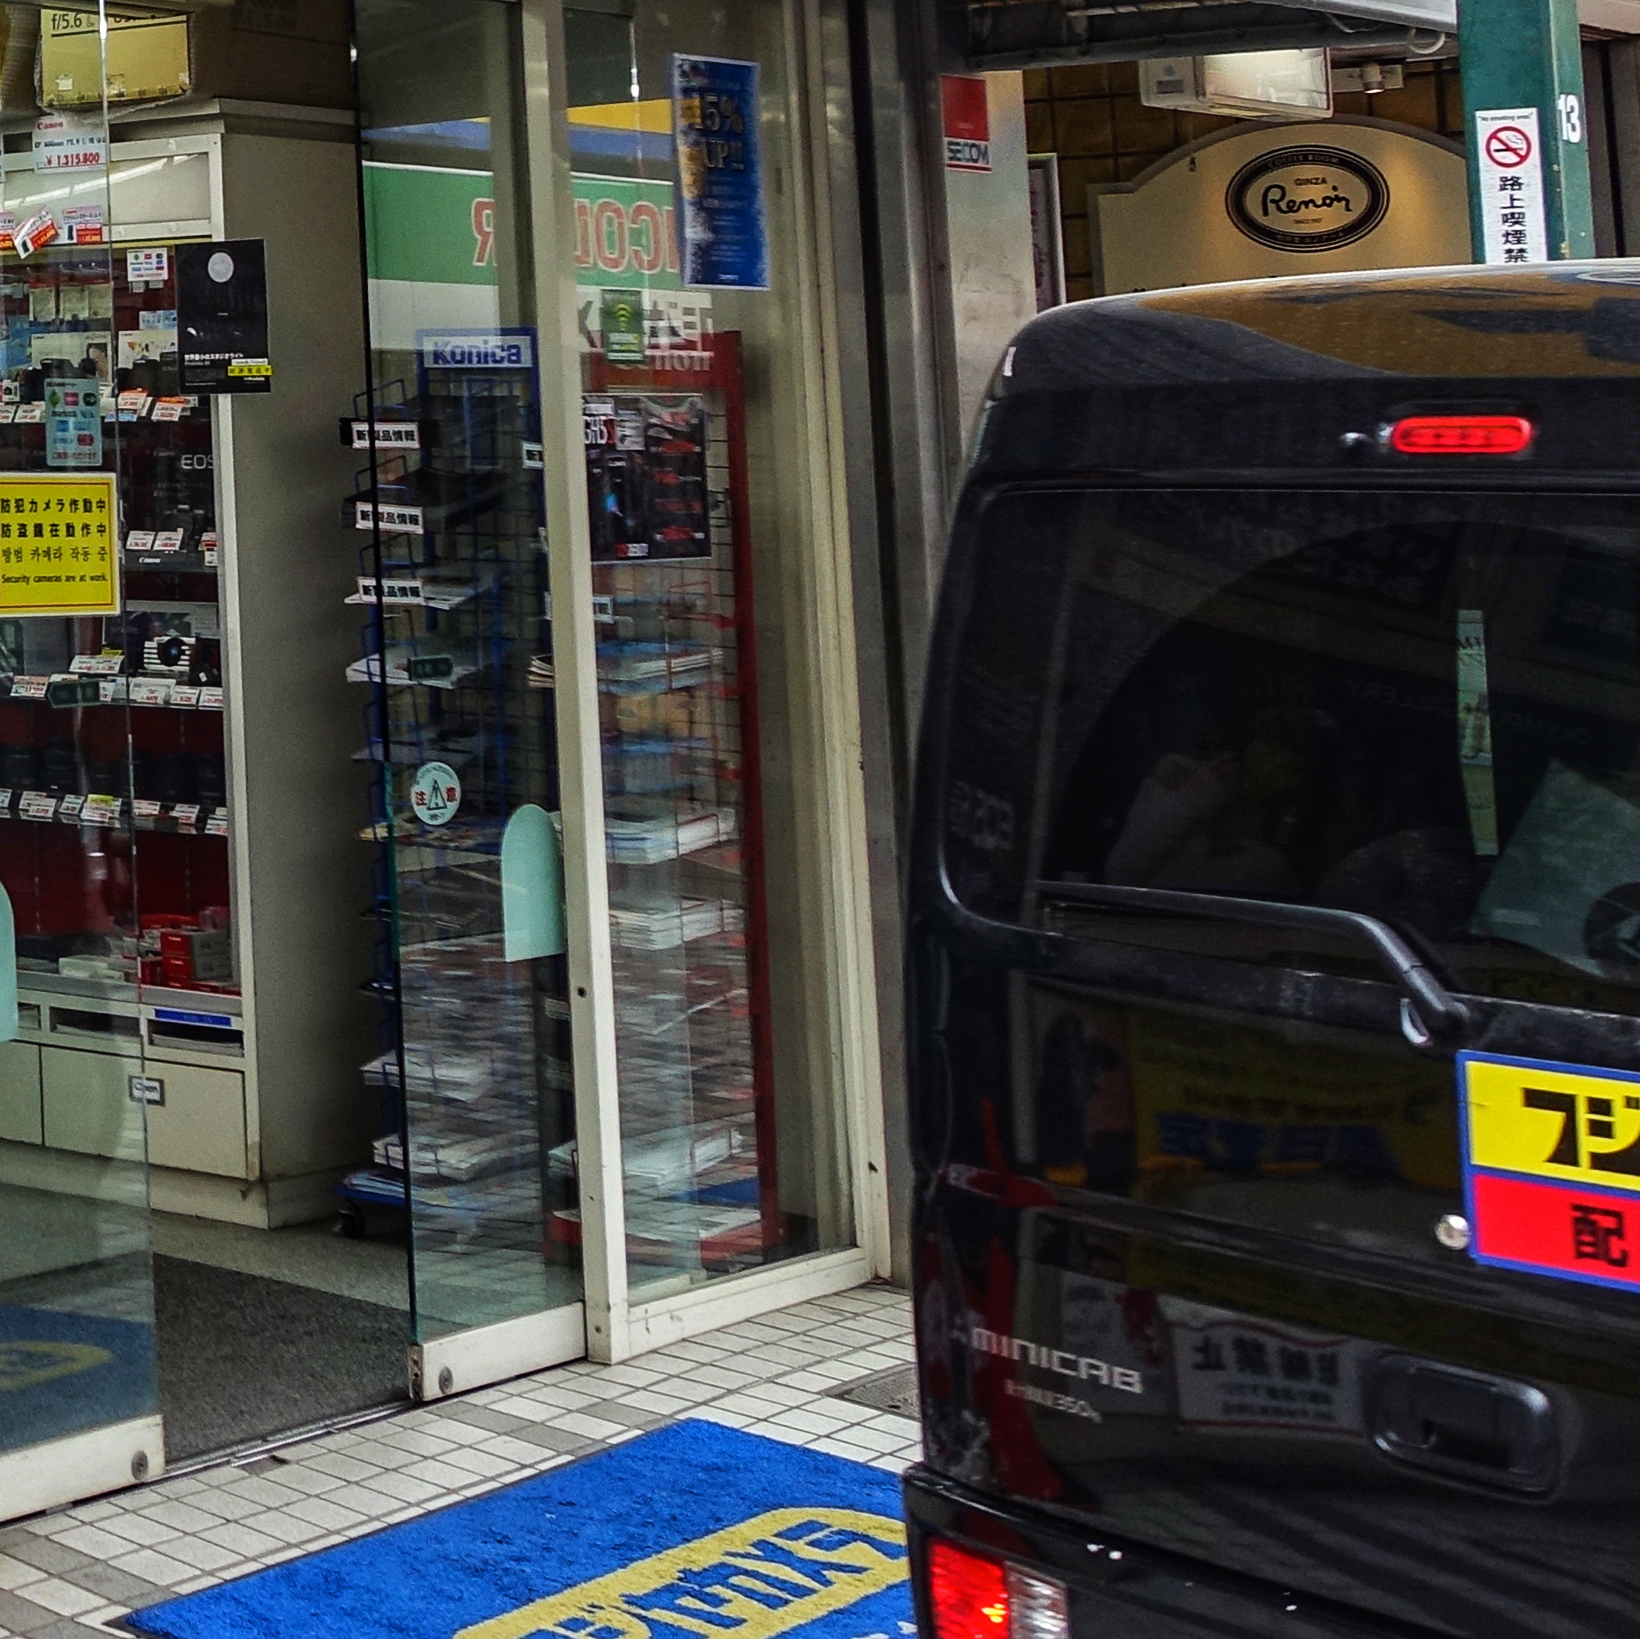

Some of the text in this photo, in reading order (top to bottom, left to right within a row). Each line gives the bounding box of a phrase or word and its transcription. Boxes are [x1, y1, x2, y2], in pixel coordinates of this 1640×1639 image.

[36, 121, 63, 131] Canon
[1558, 94, 1582, 144] 13
[947, 141, 990, 165] SECOM
[1262, 184, 1353, 218] Renoir
[1498, 175, 1530, 263] 路上喫煙禁
[433, 340, 522, 365] Konica
[0, 498, 106, 513] 防犯カメラ作動中
[1, 573, 30, 585] Security
[33, 575, 62, 583] cameras
[972, 1327, 1144, 1394] MINICAB
